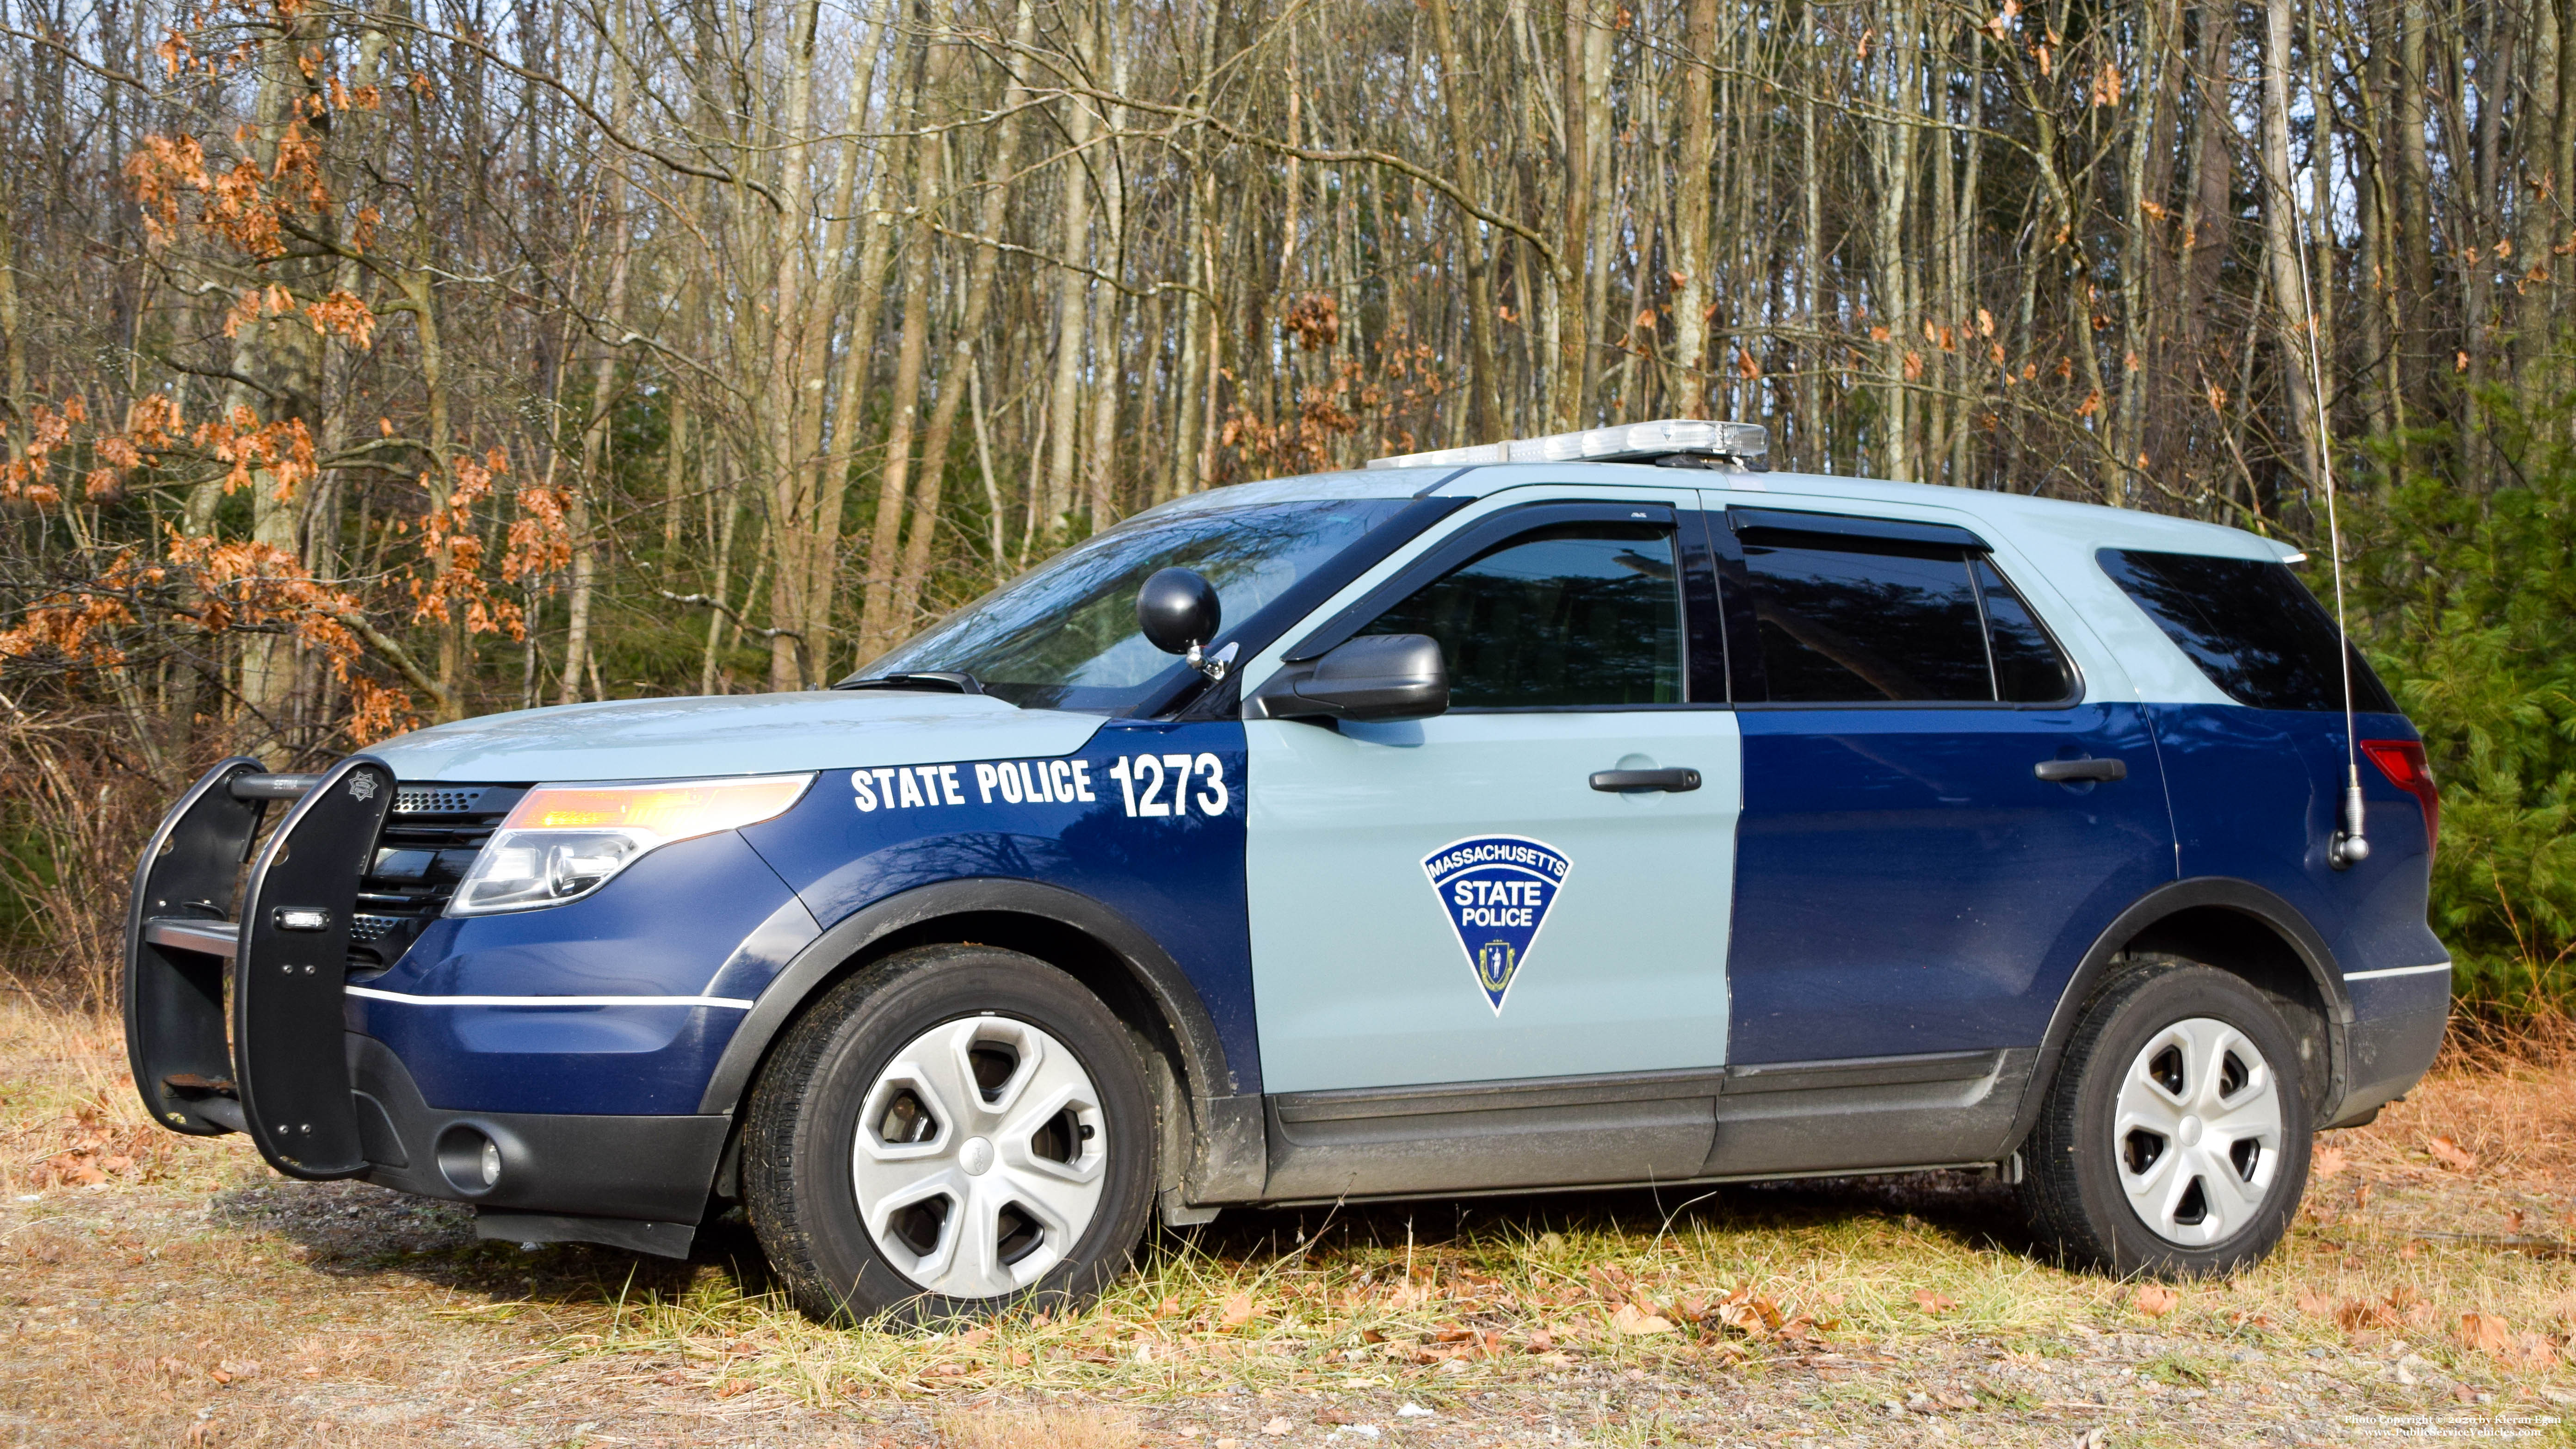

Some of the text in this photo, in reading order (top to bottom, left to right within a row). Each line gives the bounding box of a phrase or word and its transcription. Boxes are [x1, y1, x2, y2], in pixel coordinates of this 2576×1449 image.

[852, 753, 1229, 817] STATE POLICE 1273
[1427, 844, 1566, 879] MASSACHUSETTS
[1454, 880, 1542, 906] STATE
[1462, 908, 1533, 927] POLICE
